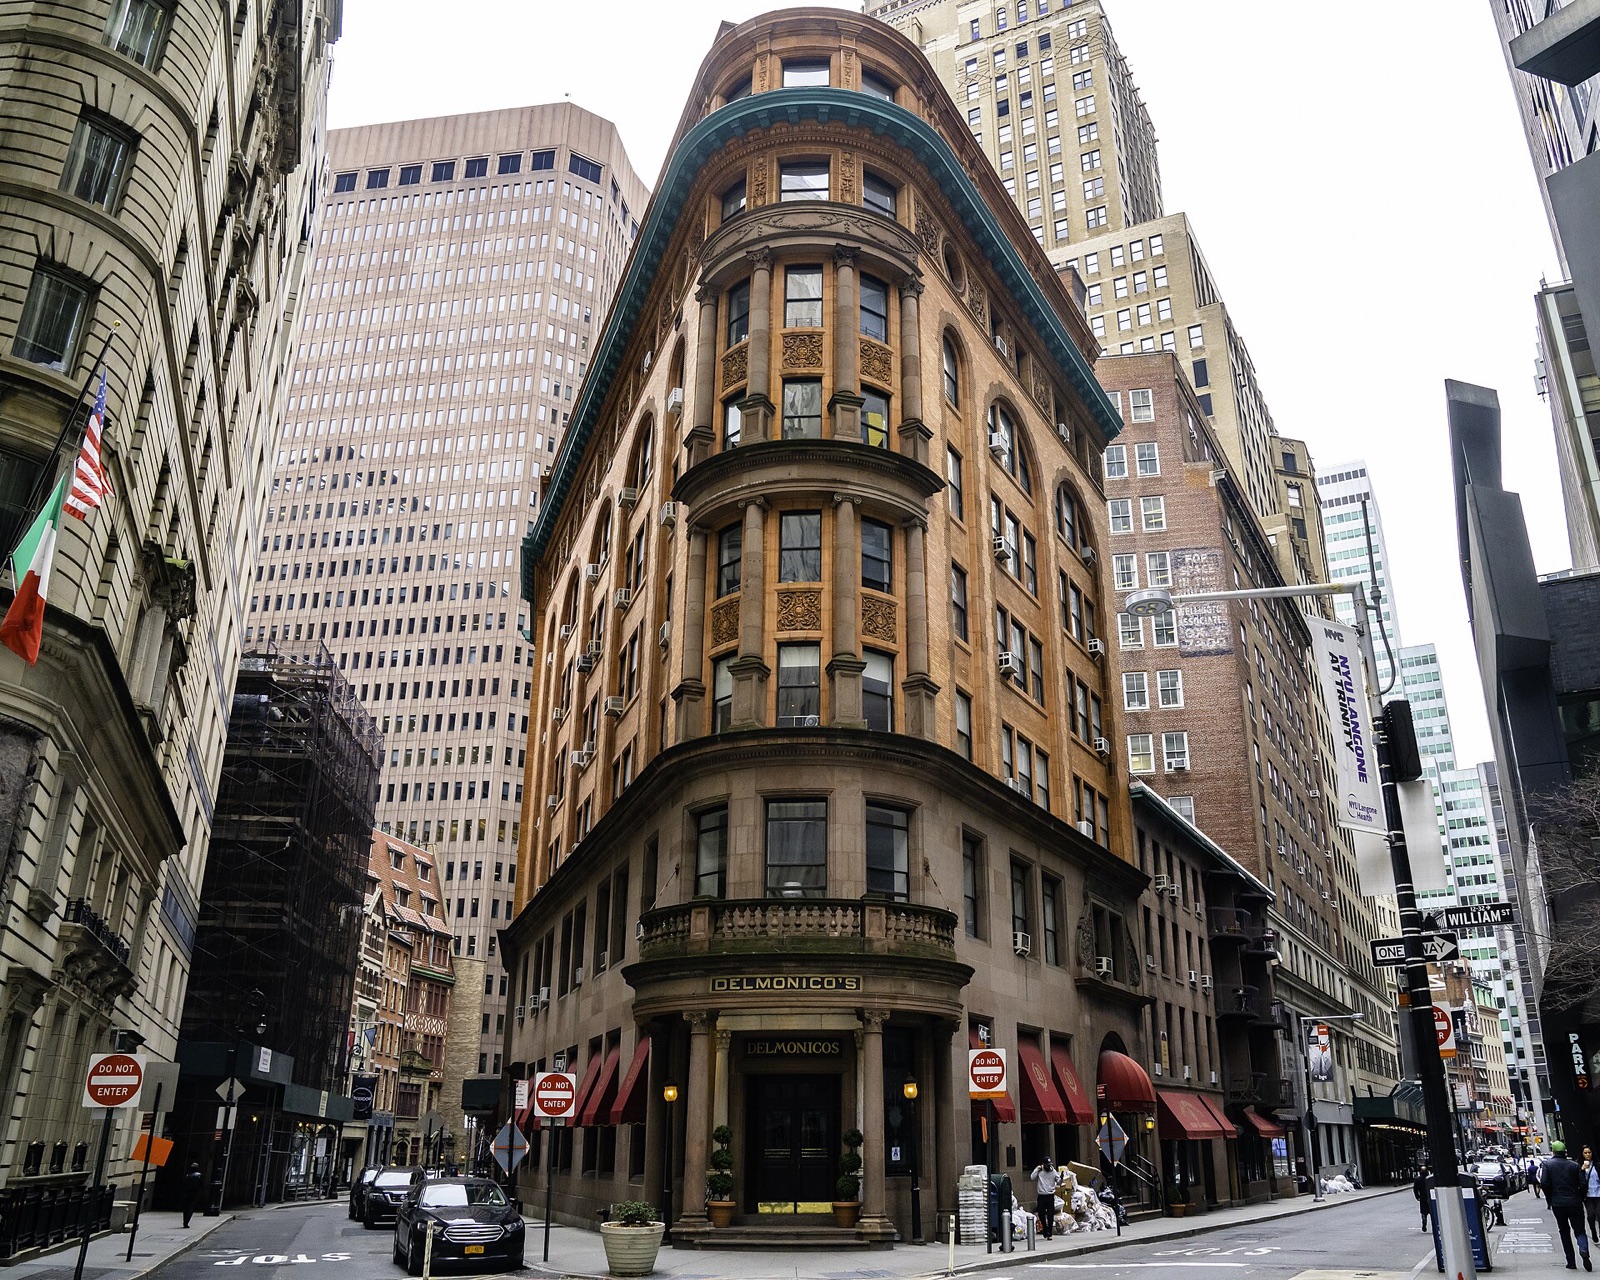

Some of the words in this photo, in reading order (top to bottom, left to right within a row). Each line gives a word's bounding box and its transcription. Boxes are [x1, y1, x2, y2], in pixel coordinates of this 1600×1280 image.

[1323, 627, 1344, 643] NYC
[1328, 650, 1342, 677] AT
[1335, 679, 1355, 753] TRINITY
[1338, 654, 1354, 694] NYU
[1346, 696, 1368, 784] LANGONE
[1348, 800, 1359, 810] NYU
[1358, 803, 1378, 815] Langone
[1356, 811, 1373, 822] Health
[1448, 910, 1501, 926] WILLIAM
[1501, 908, 1511, 916] ST
[1379, 946, 1404, 958] ONE
[714, 977, 857, 990] DELMONICO'S
[747, 1041, 840, 1054] DELMONICOS
[1569, 1033, 1587, 1075] PARK
[99, 1064, 113, 1073] DO
[115, 1064, 135, 1073] NOT
[97, 1087, 129, 1096] ENTER
[213, 1252, 352, 1266] STOP
